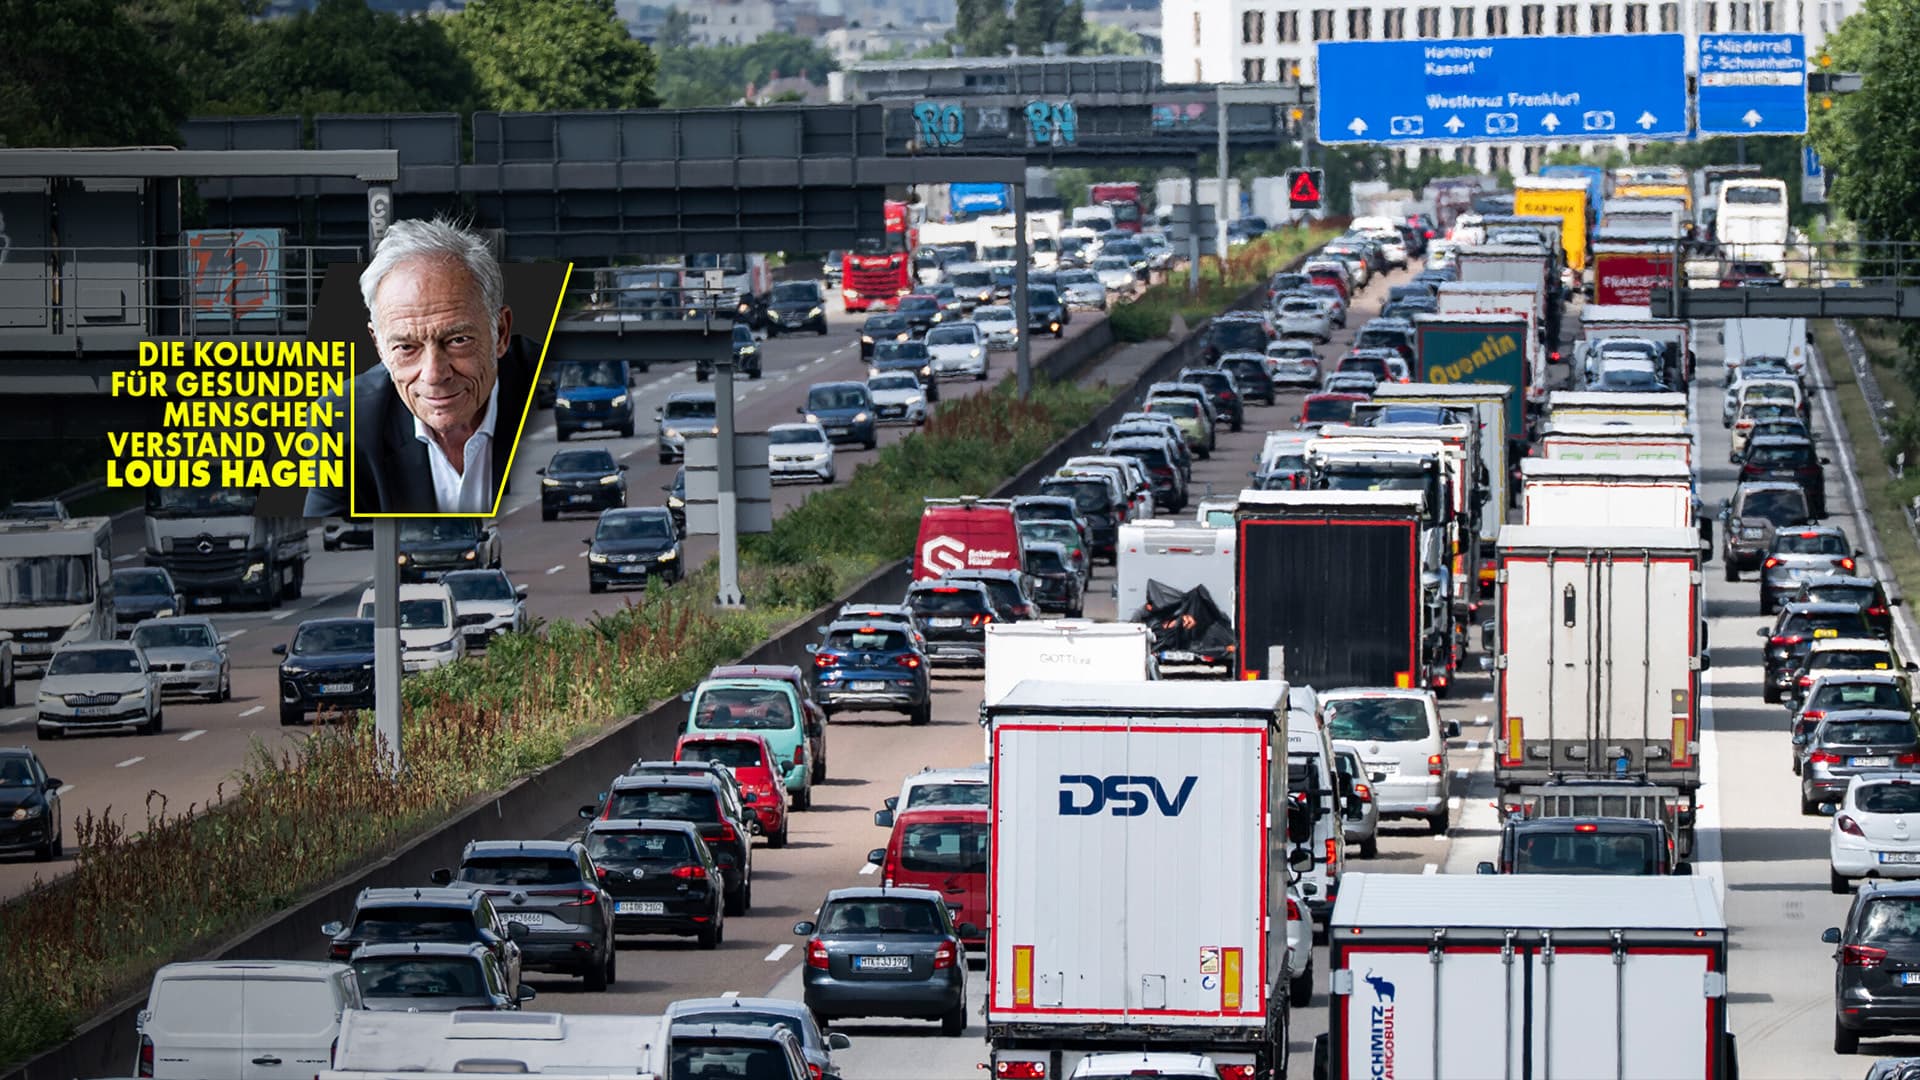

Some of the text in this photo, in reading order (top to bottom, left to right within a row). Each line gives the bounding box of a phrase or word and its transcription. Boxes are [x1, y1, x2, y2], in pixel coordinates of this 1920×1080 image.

[1424, 45, 1494, 60] Hannover
[1424, 62, 1476, 76] Kassel
[1426, 91, 1581, 109] Westkreuz Frankfurt
[1429, 334, 1517, 384] Quentin
[1059, 774, 1198, 817] DSV
